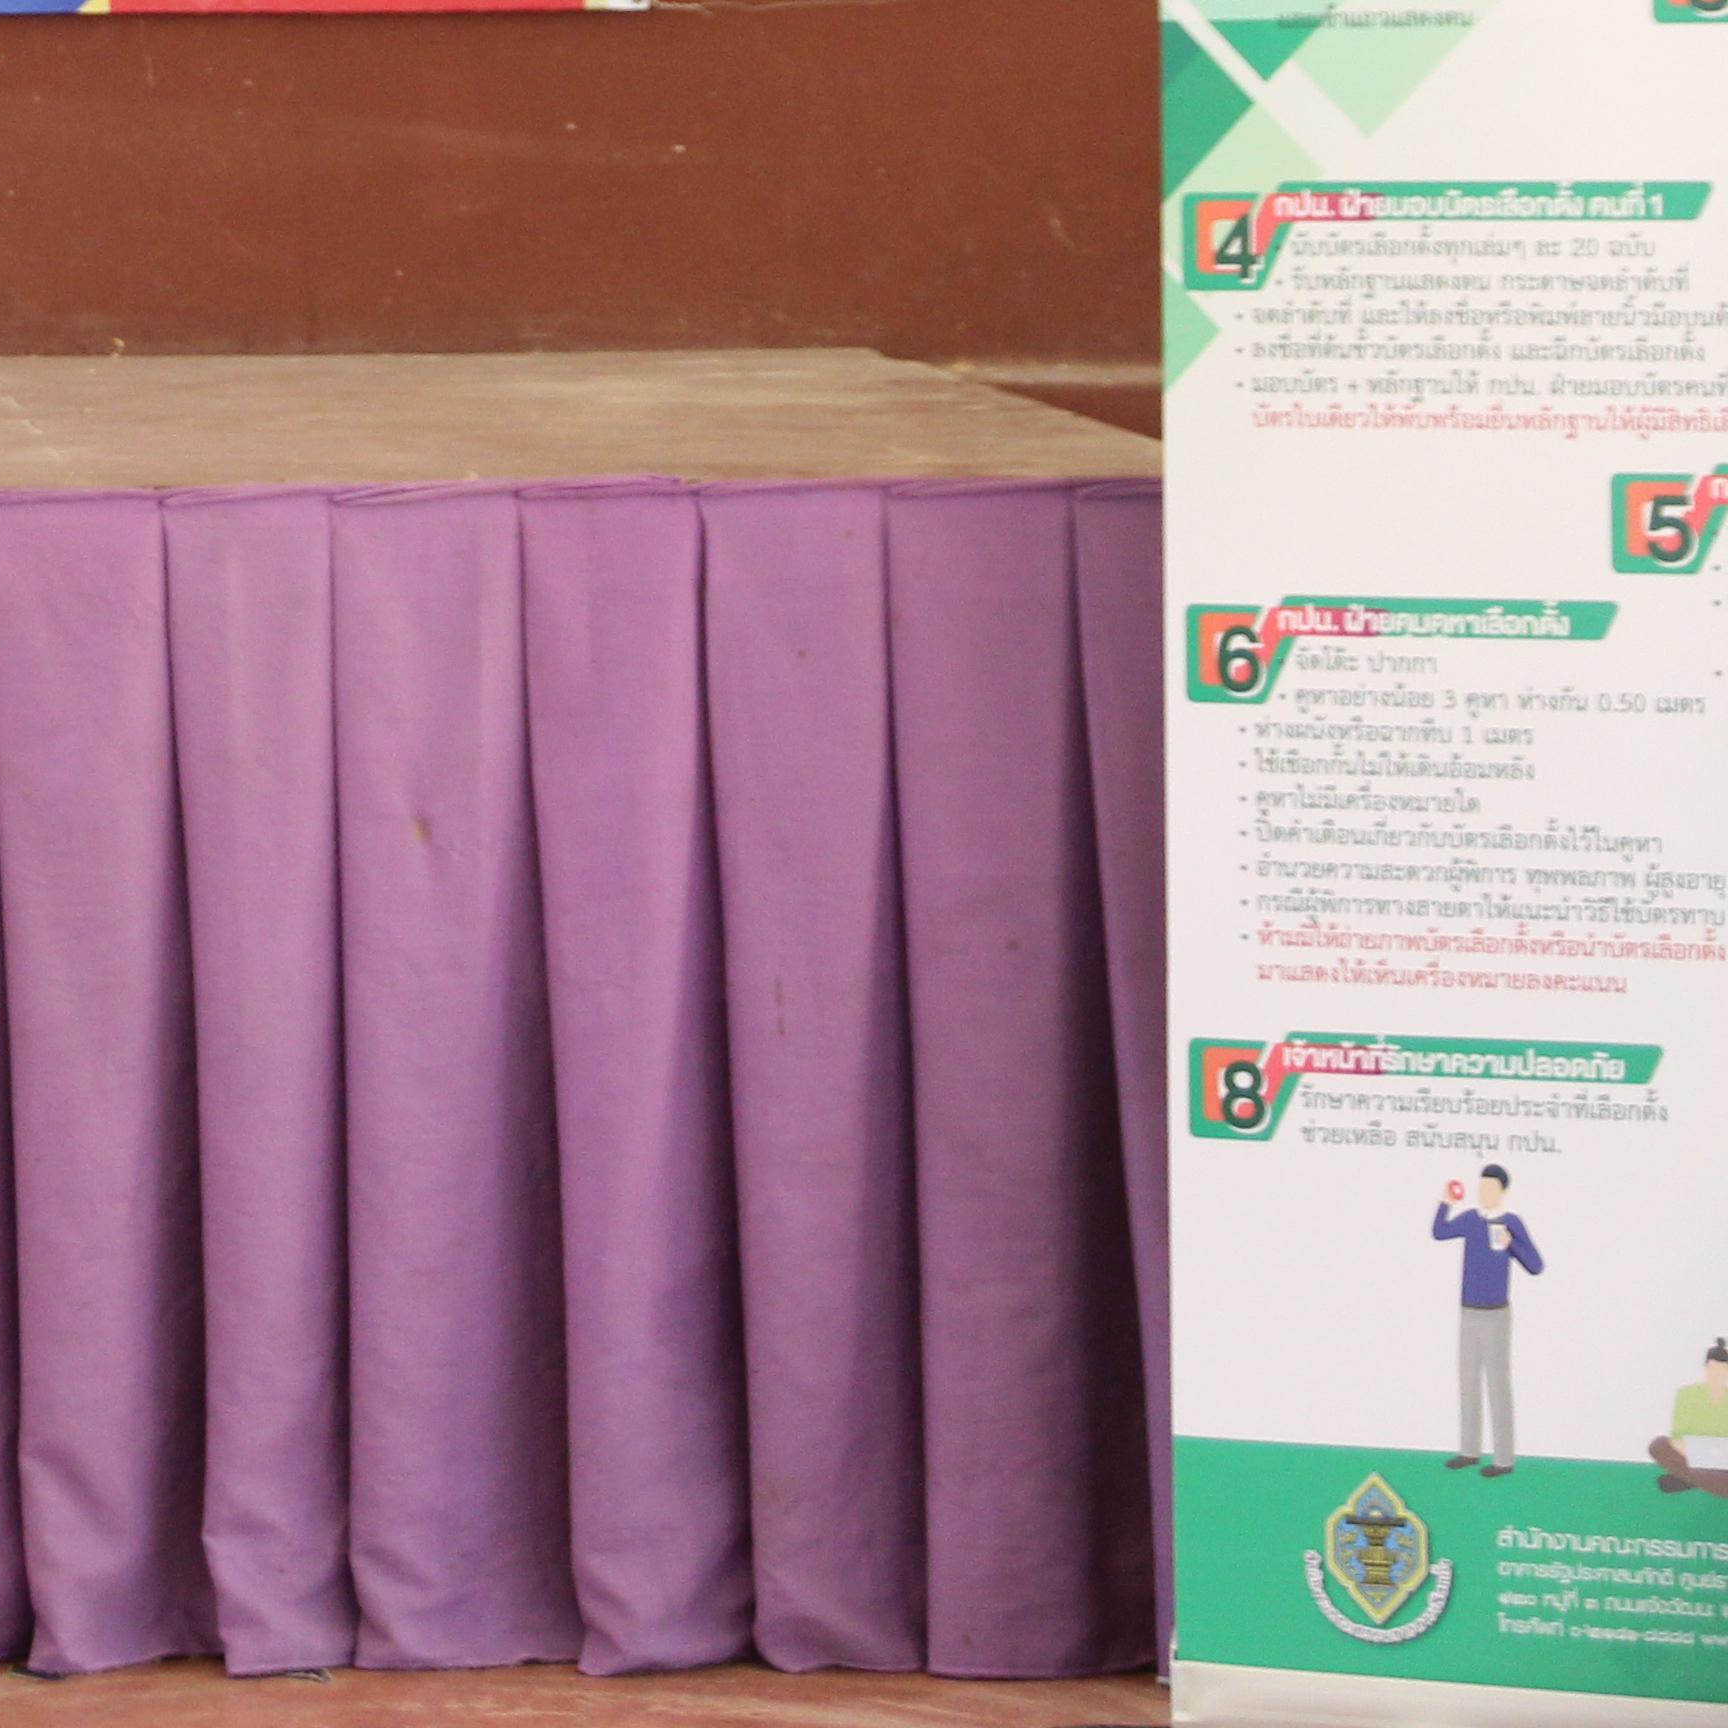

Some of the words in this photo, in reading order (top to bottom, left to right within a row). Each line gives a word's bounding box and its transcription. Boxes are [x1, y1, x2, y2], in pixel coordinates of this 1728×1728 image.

[1215, 215, 1260, 280] 4
[1651, 191, 1664, 216] 1
[1647, 494, 1691, 563] 5
[1217, 625, 1264, 693] 6
[1597, 693, 1647, 714] 0.50
[1223, 1059, 1266, 1130] 8
